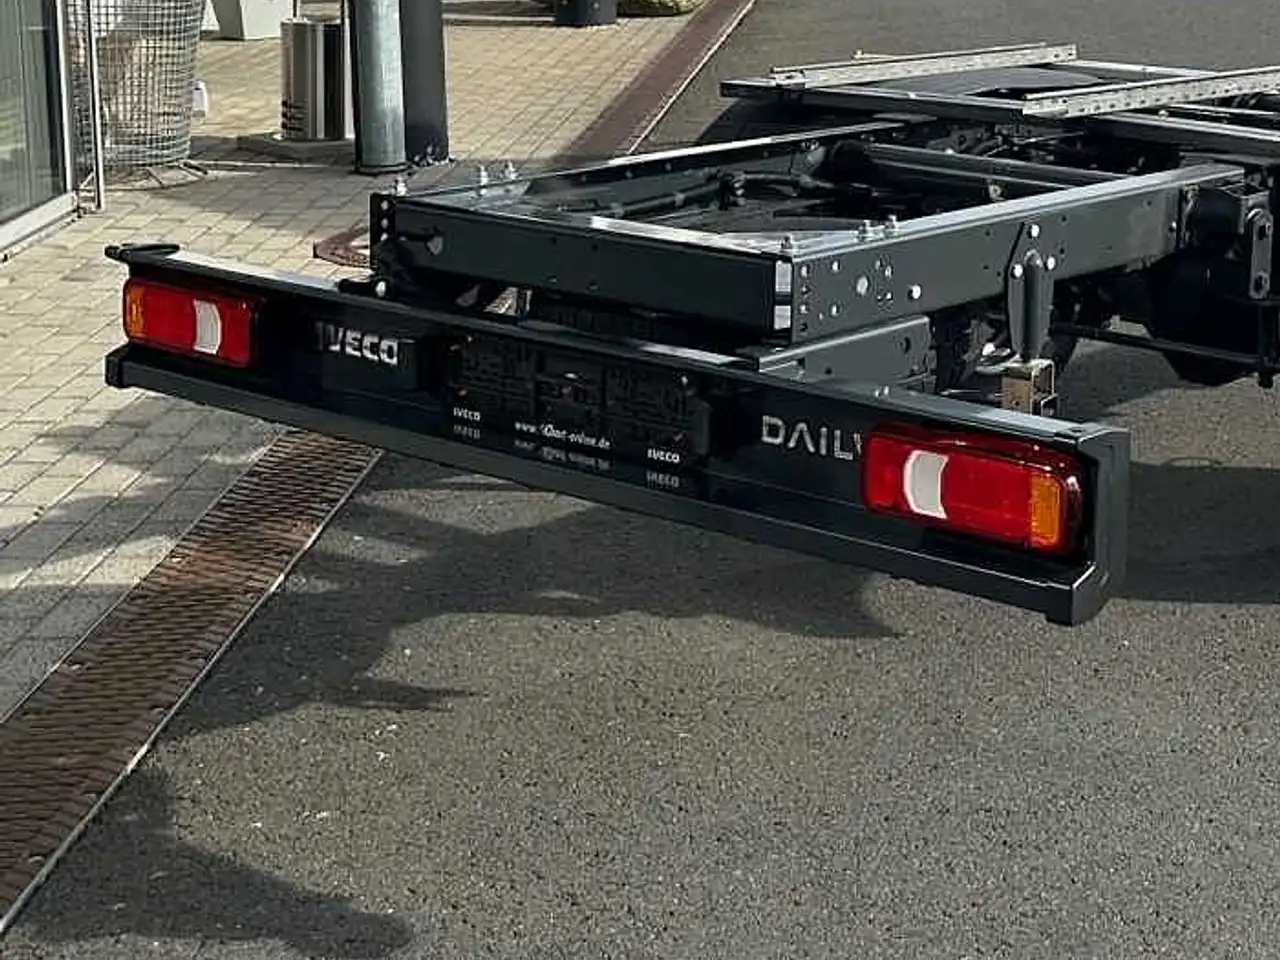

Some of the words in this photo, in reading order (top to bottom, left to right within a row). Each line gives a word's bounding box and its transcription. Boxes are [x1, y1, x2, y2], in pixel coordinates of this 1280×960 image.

[316, 321, 398, 366] IVECO
[453, 406, 481, 423] IVECO
[647, 448, 681, 464] IVECO
